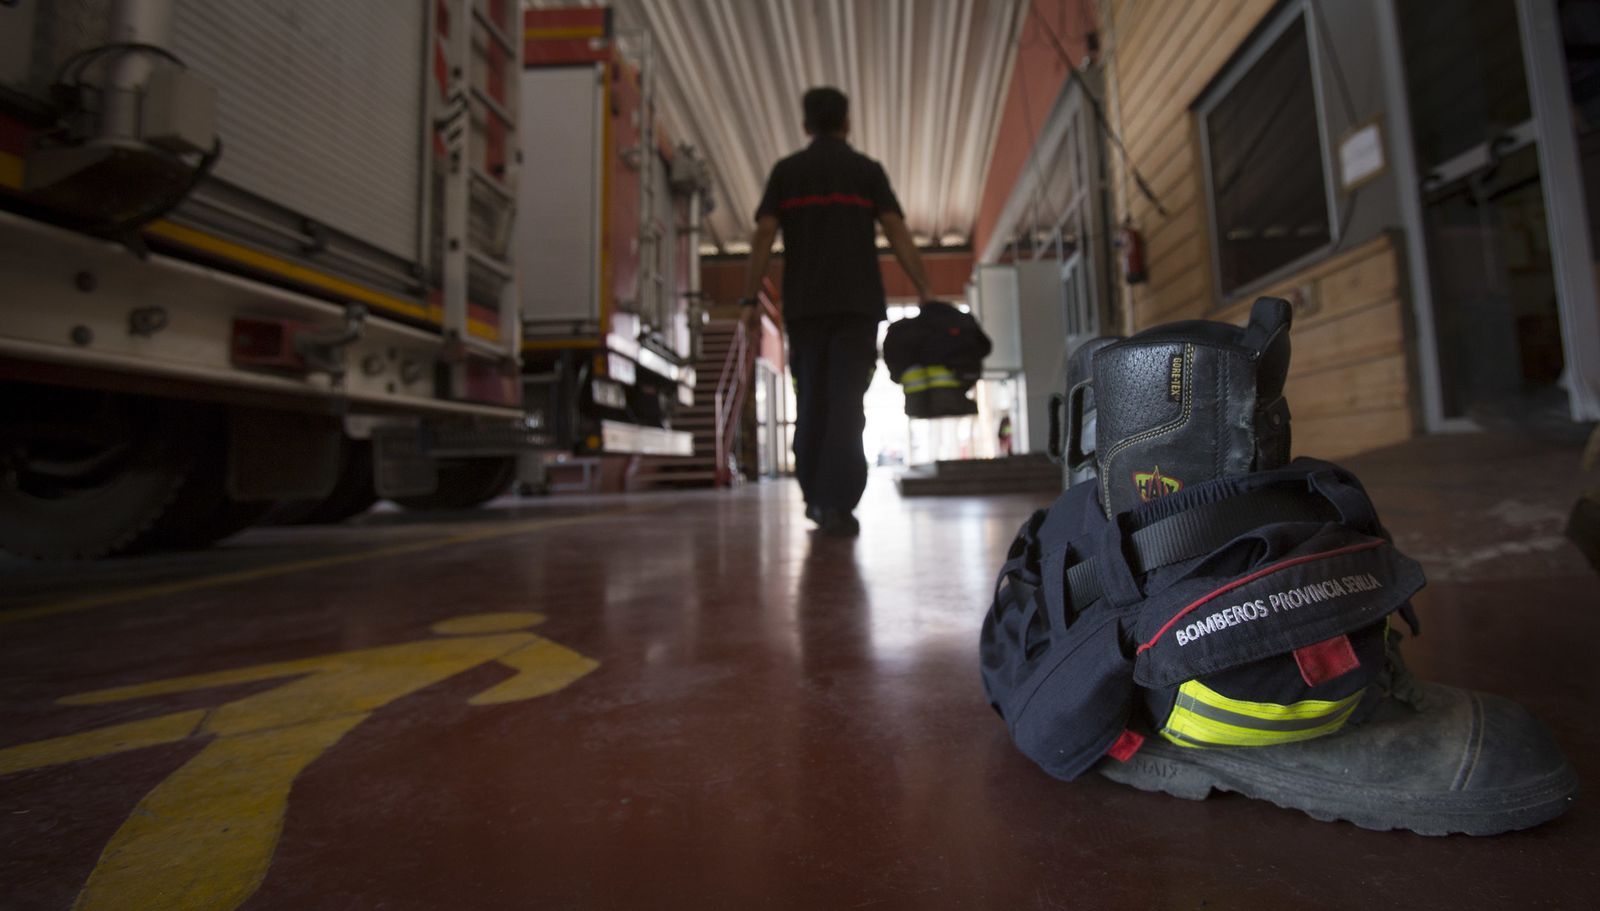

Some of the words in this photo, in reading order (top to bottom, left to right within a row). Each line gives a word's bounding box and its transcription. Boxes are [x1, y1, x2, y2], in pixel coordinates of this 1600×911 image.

[1170, 357, 1183, 396] GORE-TEX
[1175, 599, 1269, 647] BOMBEROS
[1268, 578, 1348, 613] PROVINCIA
[1340, 572, 1383, 594] SEVILLA
